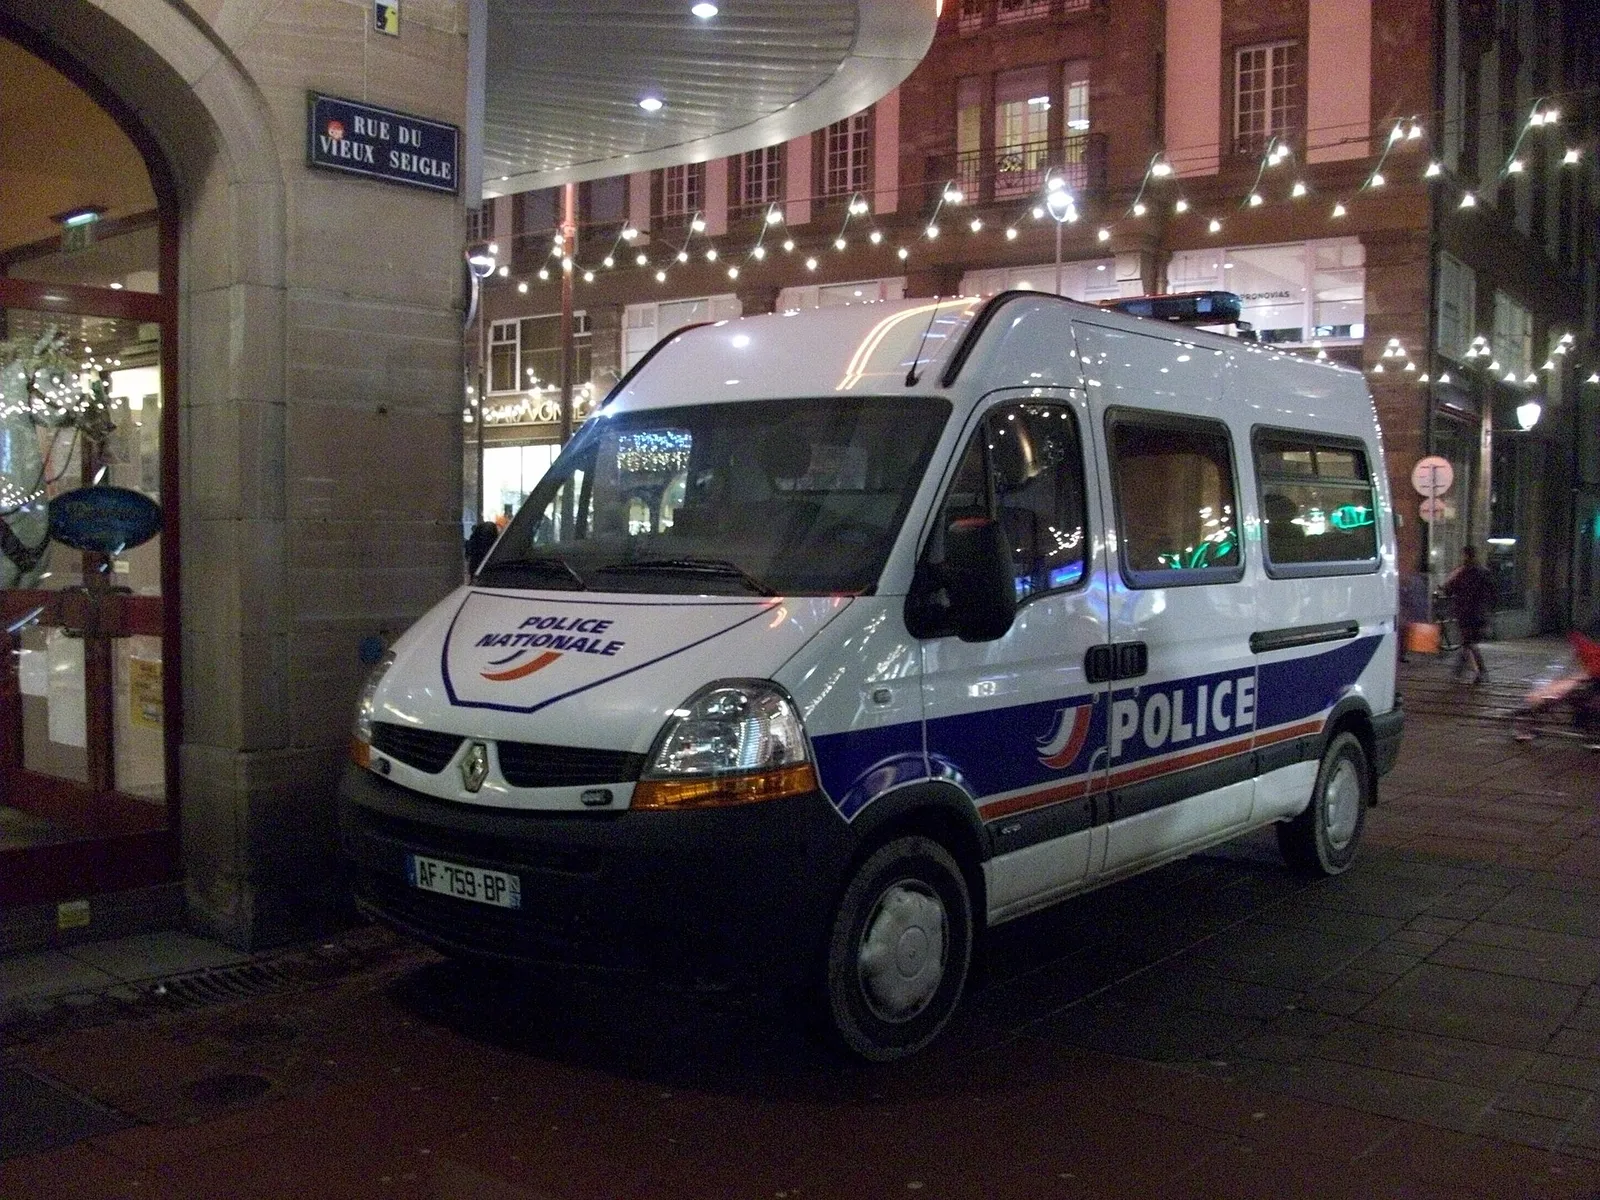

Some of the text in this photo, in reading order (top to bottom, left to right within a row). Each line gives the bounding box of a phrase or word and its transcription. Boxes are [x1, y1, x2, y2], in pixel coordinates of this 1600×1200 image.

[353, 115, 422, 147] RUE DU
[319, 135, 451, 180] VIEUX SEIGLE
[1240, 290, 1290, 301] PRONOVIAS
[518, 616, 614, 634] POLICE
[475, 633, 626, 656] NATIONALE
[1110, 676, 1255, 758] POLICE
